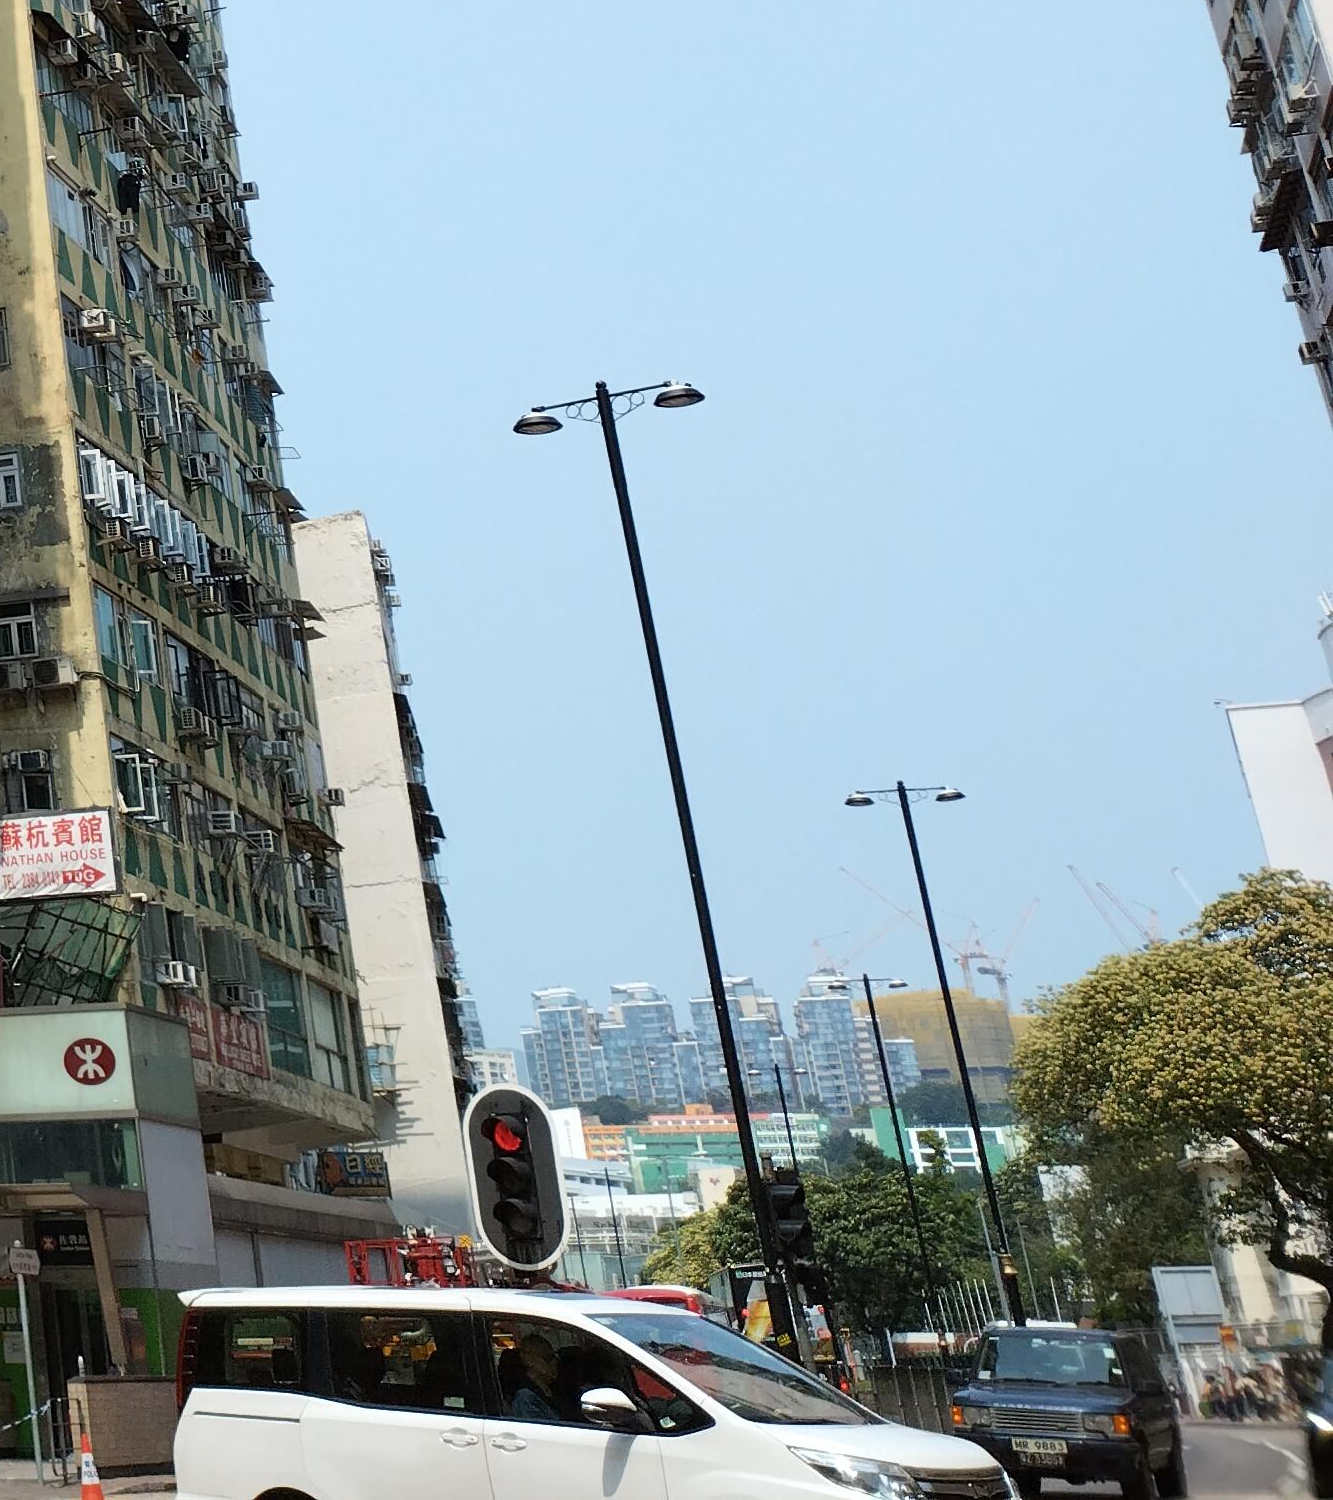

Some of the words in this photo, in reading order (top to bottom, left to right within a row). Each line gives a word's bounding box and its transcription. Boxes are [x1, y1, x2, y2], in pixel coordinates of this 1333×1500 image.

[0, 815, 103, 853] 蘇杭賓館
[1, 852, 53, 868] NATHAN
[60, 847, 106, 862] HOUSE
